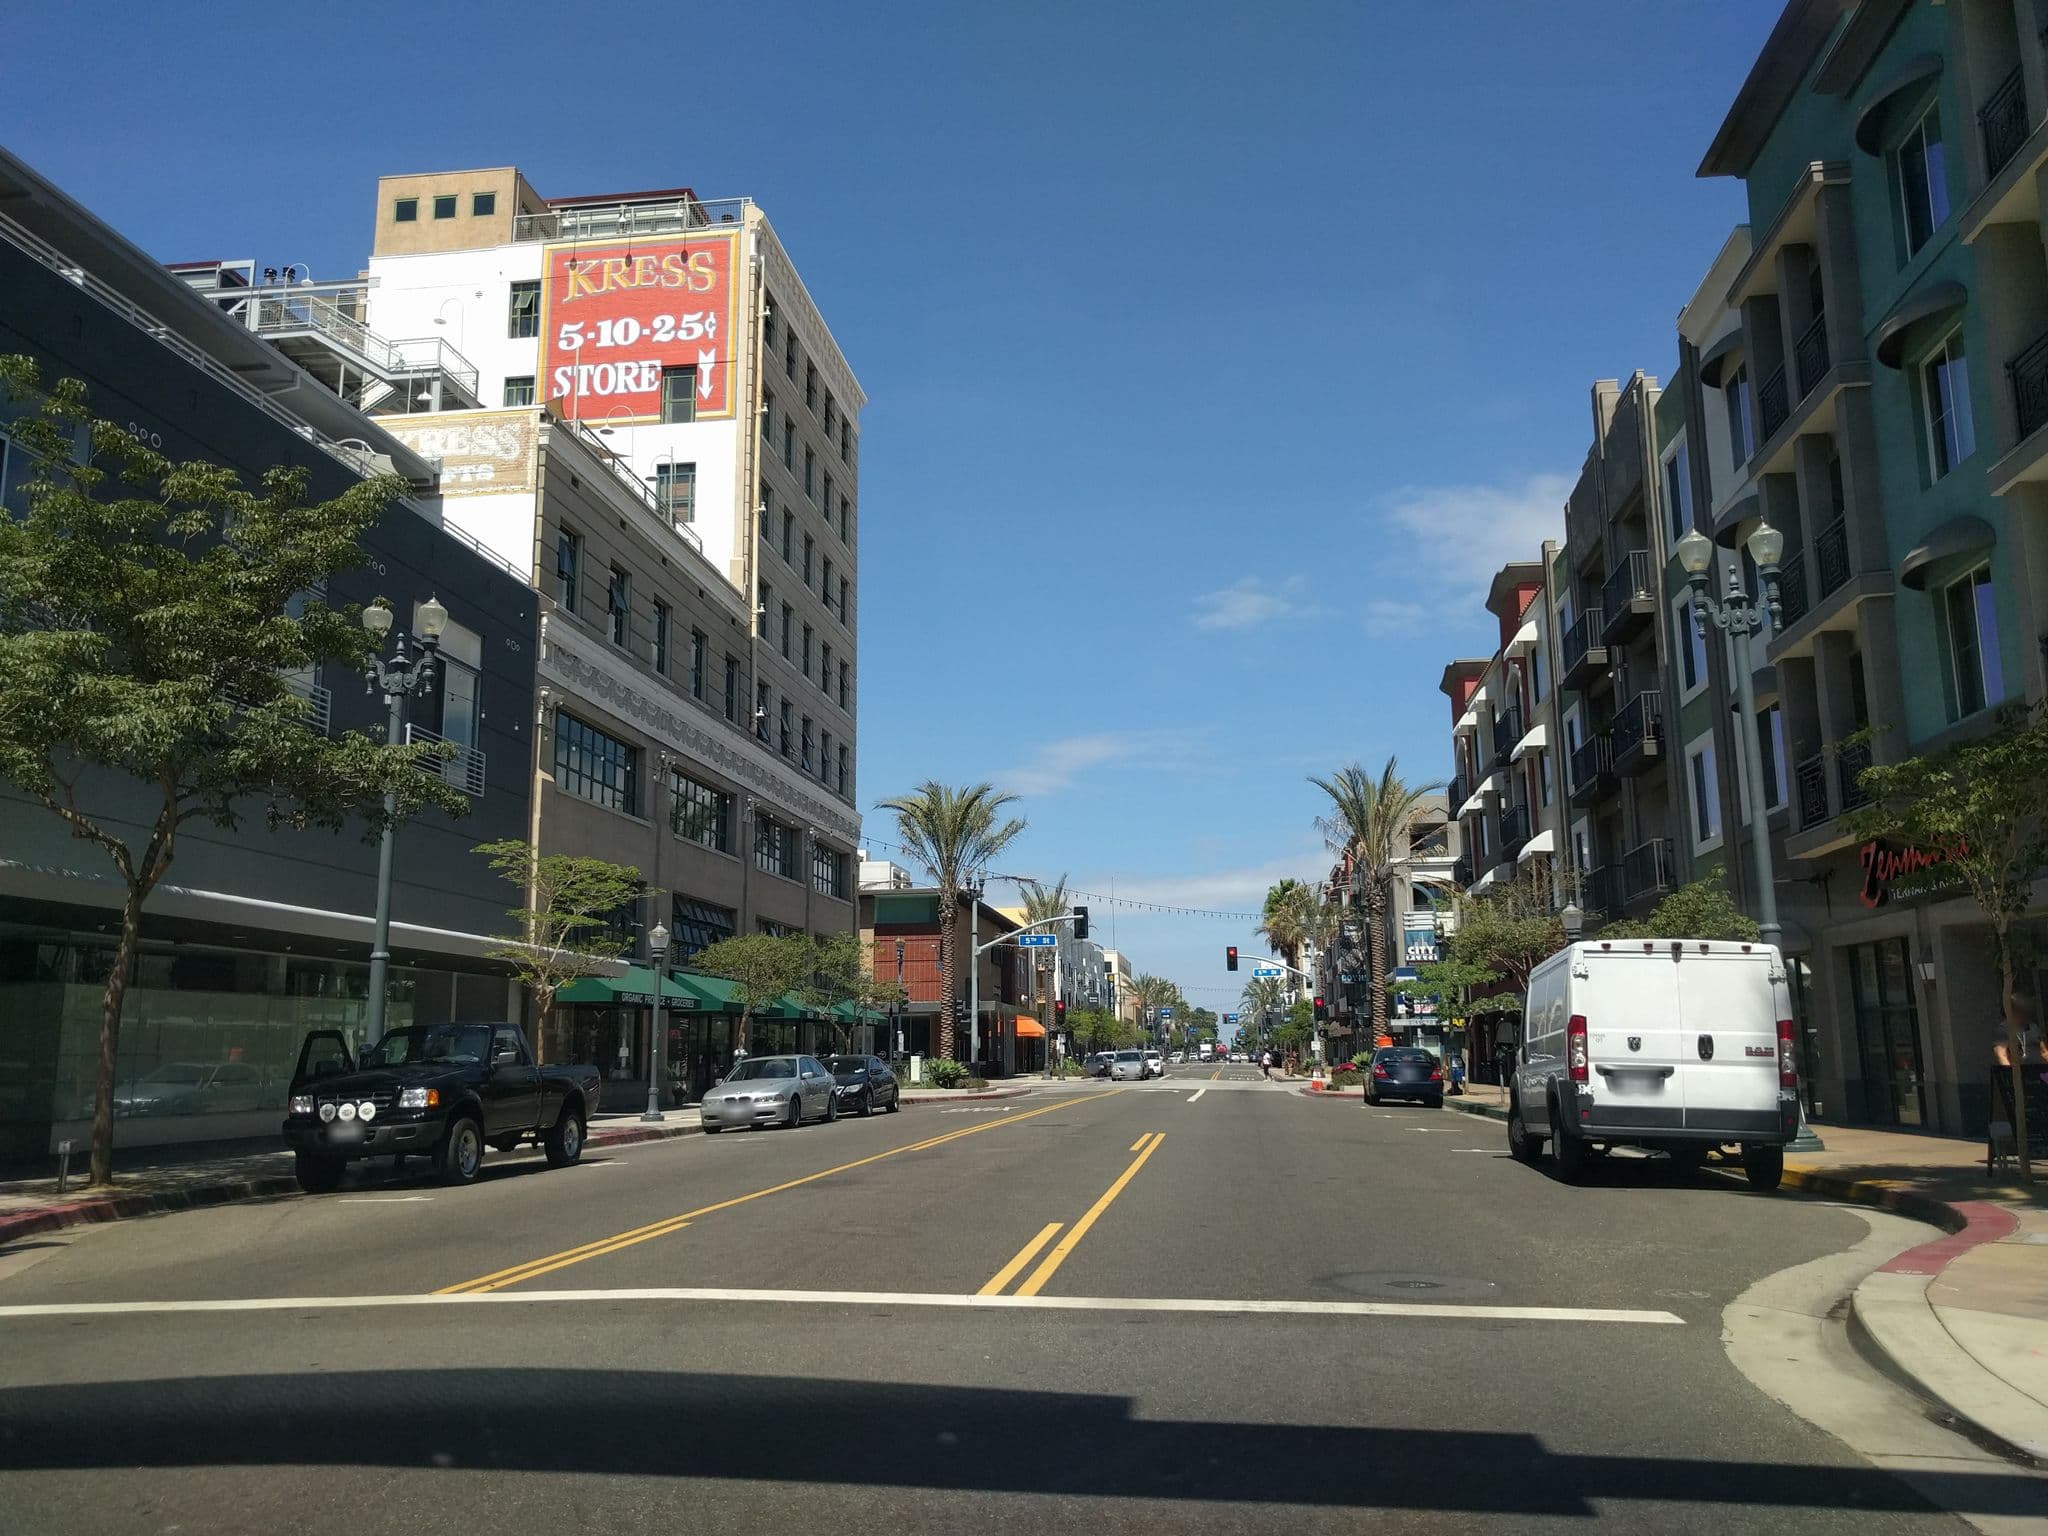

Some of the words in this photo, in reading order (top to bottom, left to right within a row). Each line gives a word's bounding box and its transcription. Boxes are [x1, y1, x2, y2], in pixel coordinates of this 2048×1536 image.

[562, 250, 717, 304] KRESS
[553, 360, 662, 398] STORE
[1408, 946, 1434, 954] CITY
[621, 993, 643, 1003] ORGANIC
